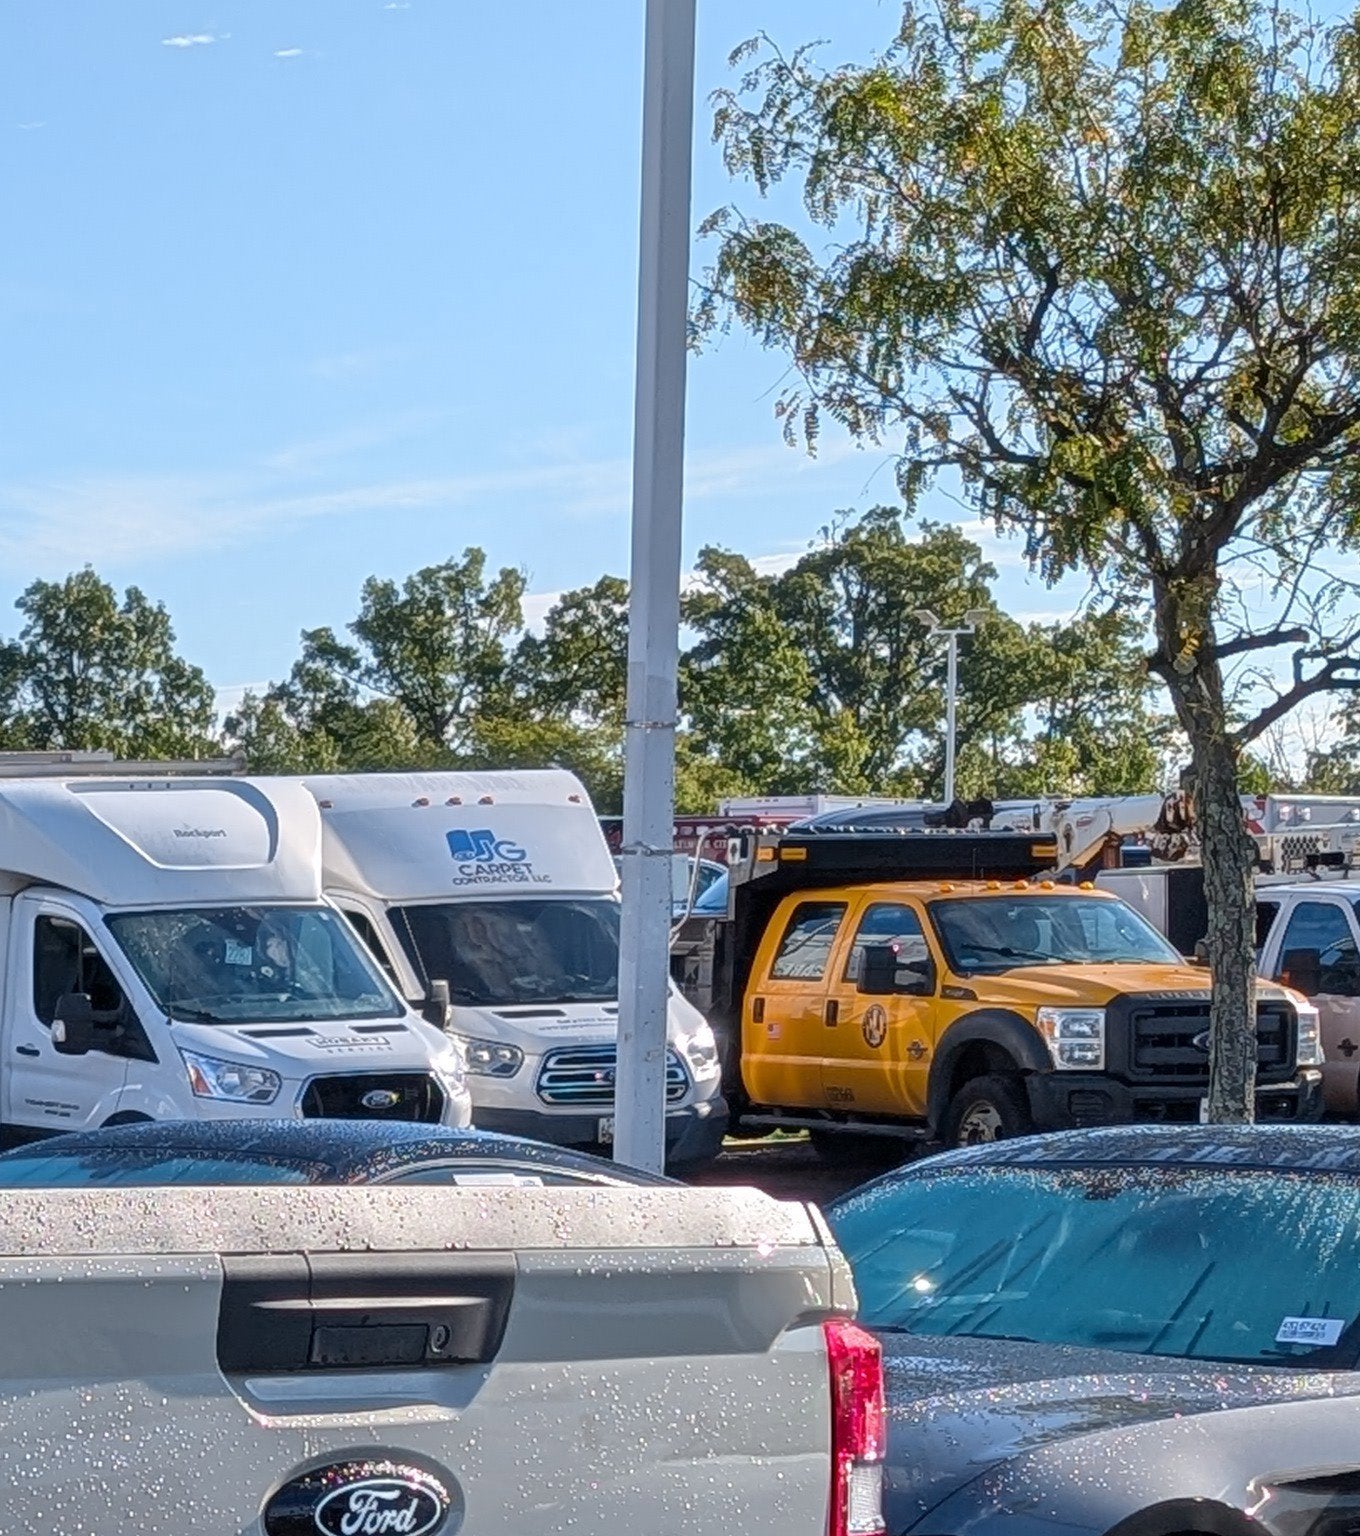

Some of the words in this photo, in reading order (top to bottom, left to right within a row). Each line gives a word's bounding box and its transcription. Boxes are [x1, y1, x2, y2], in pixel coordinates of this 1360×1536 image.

[458, 862, 533, 877] CARPET
[452, 874, 529, 886] CONTRACTOR
[531, 874, 552, 884] LLC
[340, 1488, 420, 1536] Ford
